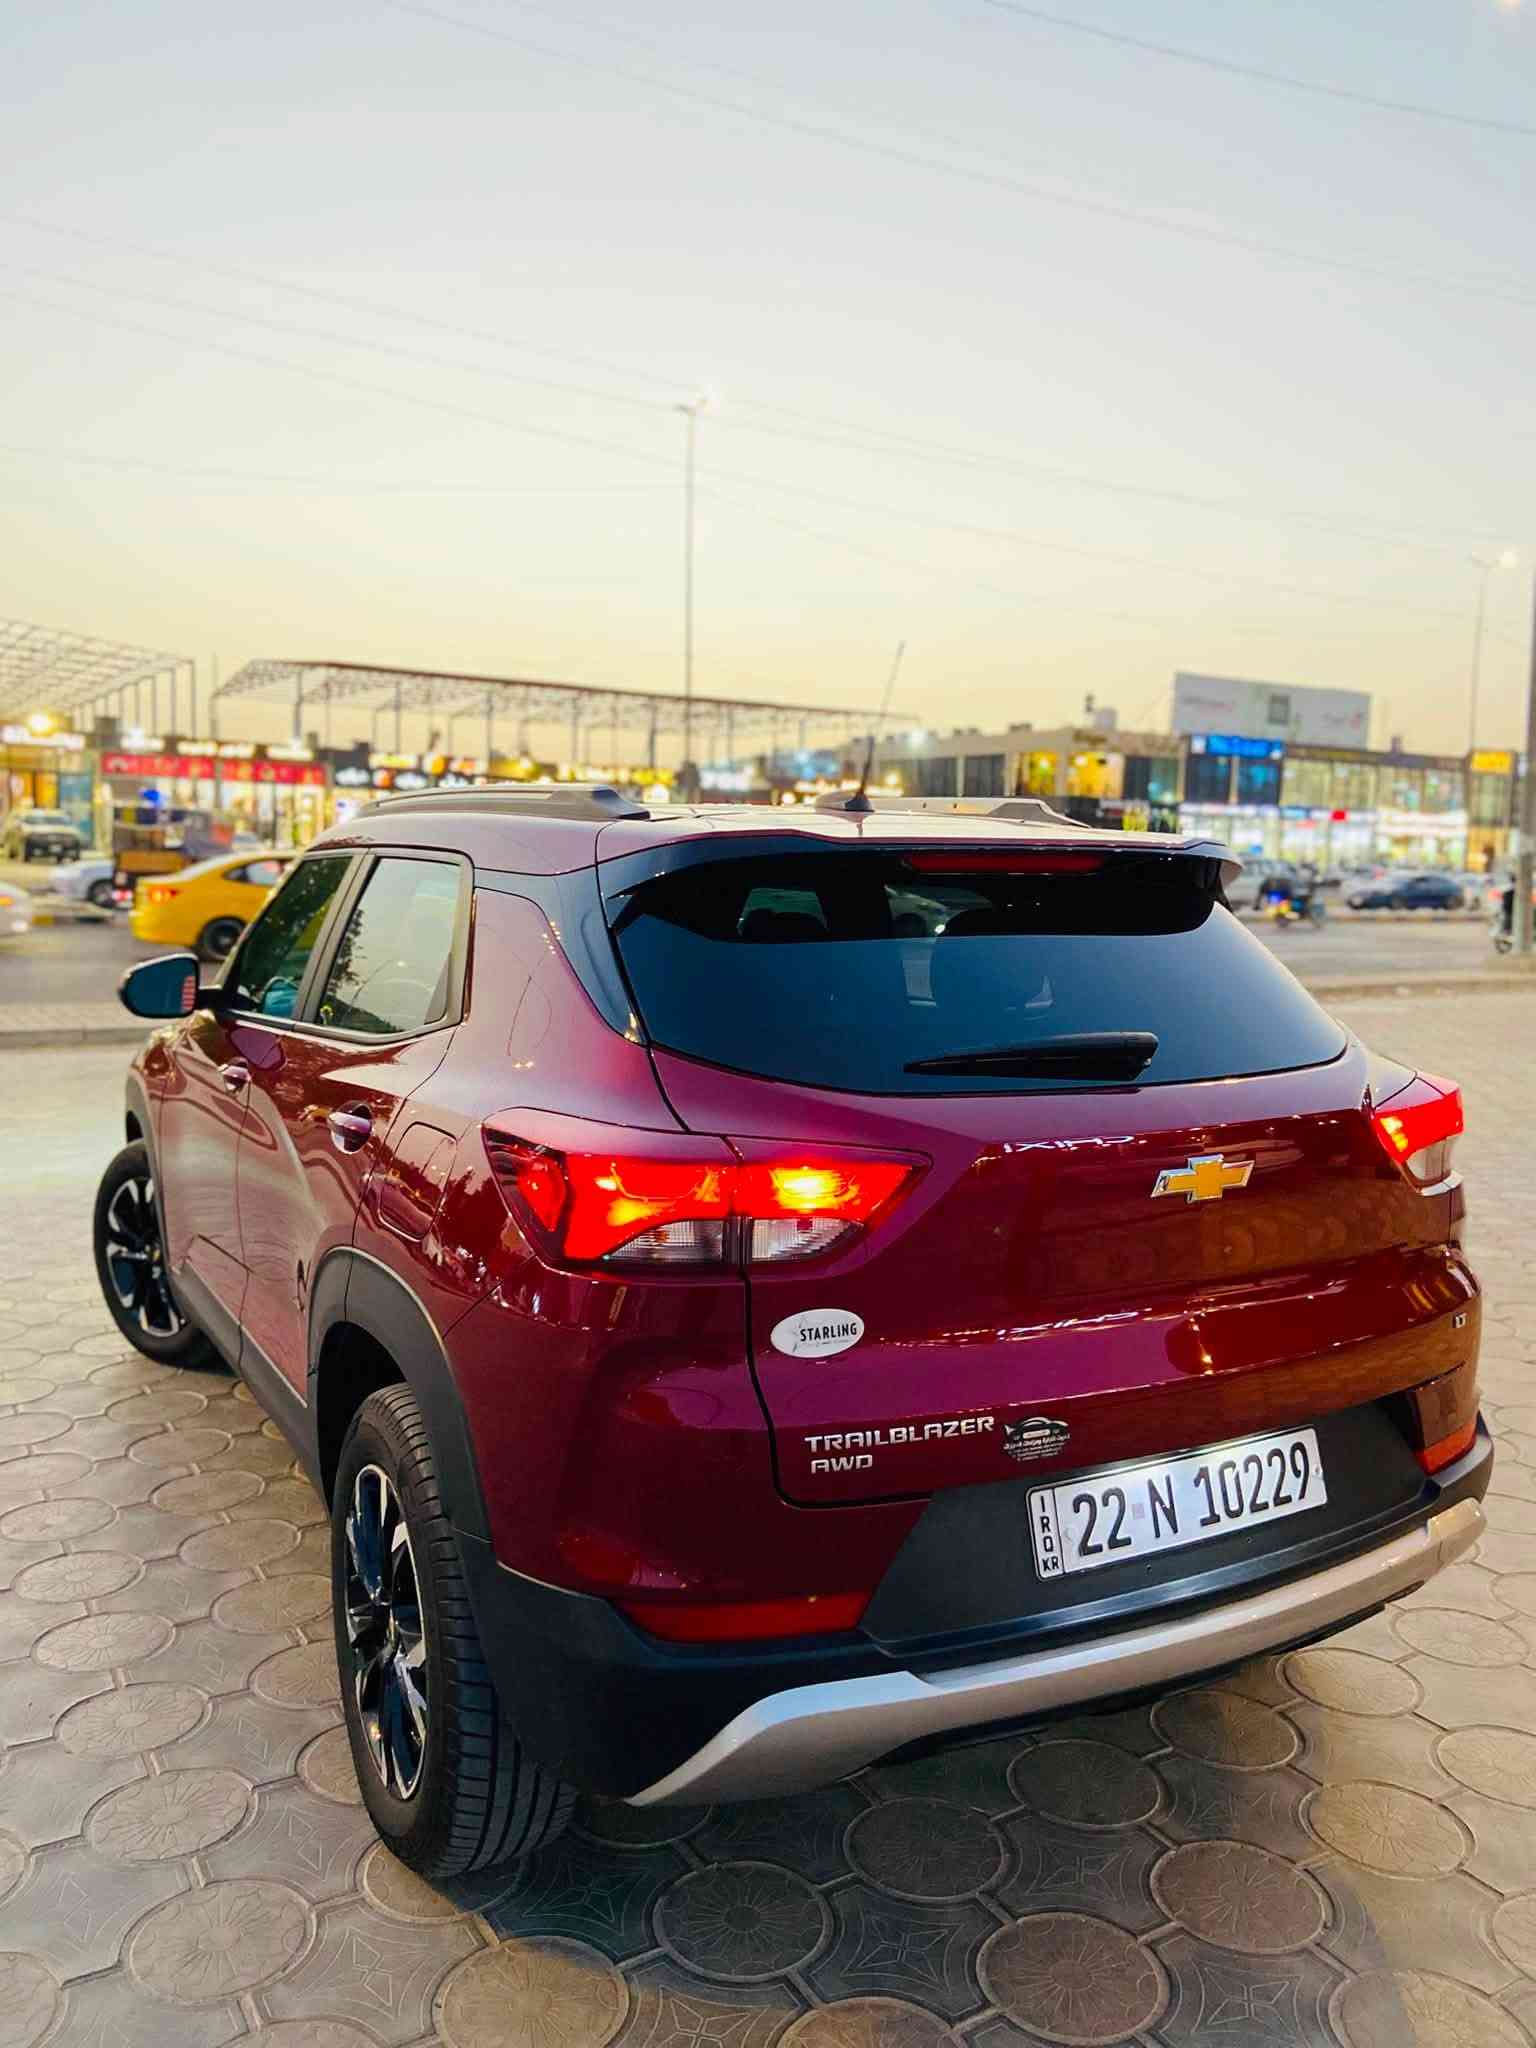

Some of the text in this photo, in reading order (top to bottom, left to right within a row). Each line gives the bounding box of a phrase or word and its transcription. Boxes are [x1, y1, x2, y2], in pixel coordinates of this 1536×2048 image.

[799, 1322, 858, 1342] STARLING
[804, 1416, 995, 1453] TRAILBLAZER
[810, 1454, 873, 1474] AWD
[1072, 1441, 1310, 1557] 22 N 10229
[1042, 1555, 1060, 1572] KR
